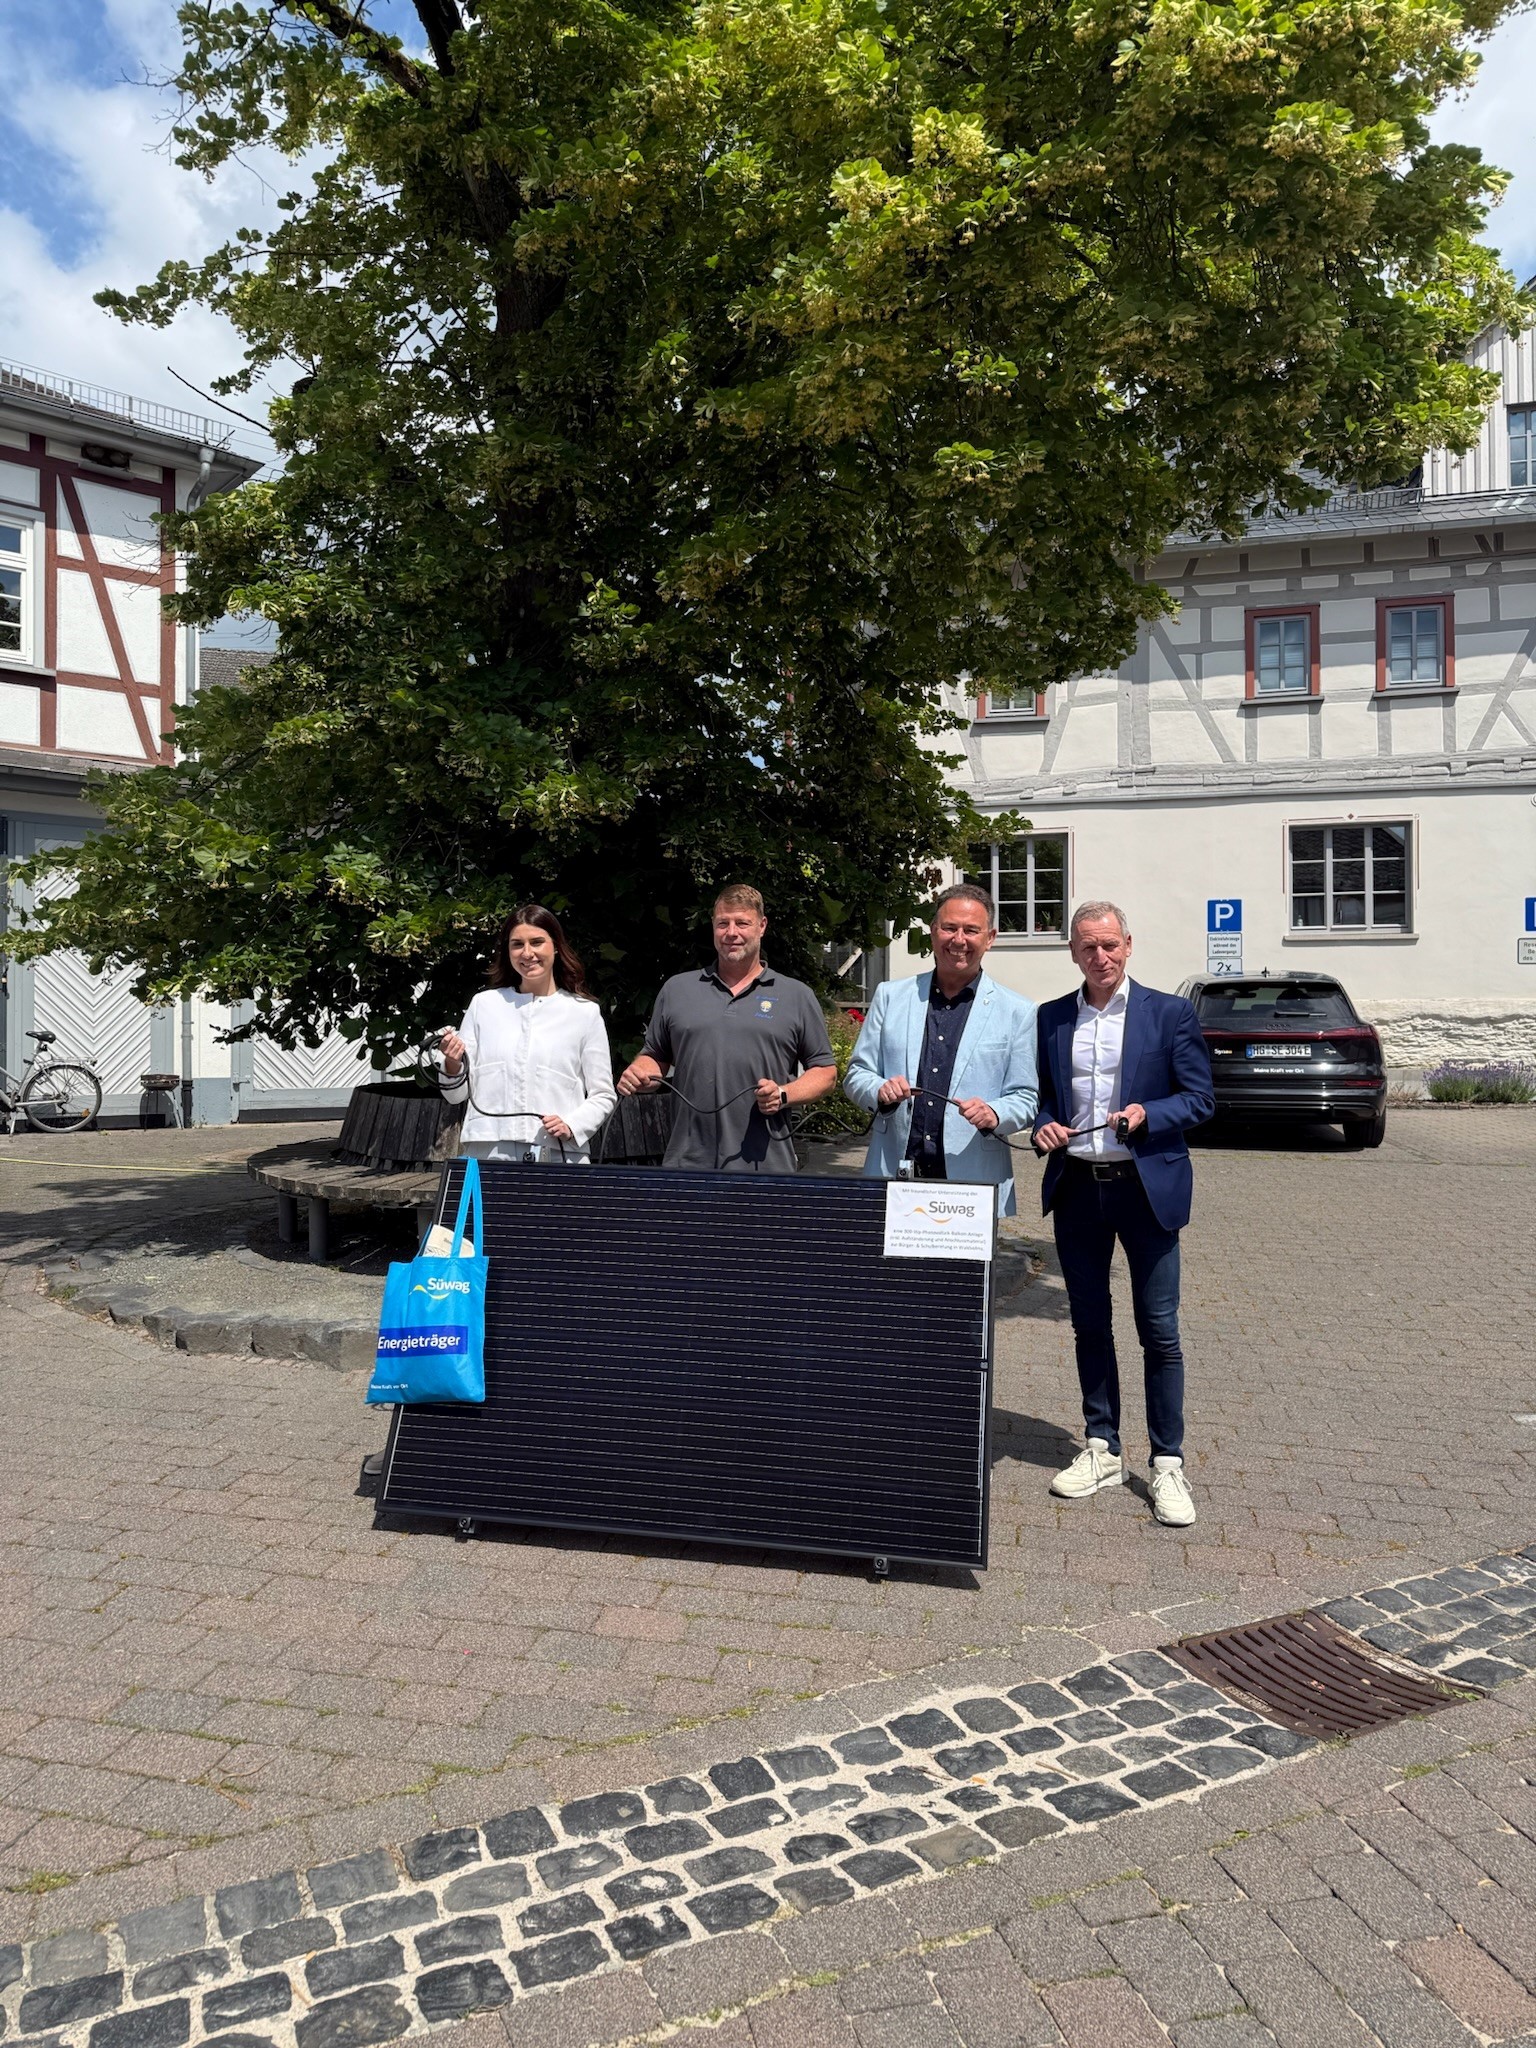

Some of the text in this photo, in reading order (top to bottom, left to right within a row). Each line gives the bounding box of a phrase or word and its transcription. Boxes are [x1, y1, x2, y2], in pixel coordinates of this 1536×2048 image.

[1215, 903, 1234, 928] P
[1217, 962, 1232, 972] 2x
[1253, 1045, 1265, 1055] HG
[1271, 1045, 1284, 1055] SE
[928, 1200, 975, 1218] Süwag
[427, 1278, 470, 1294] Süwag
[378, 1334, 461, 1352] Energieträger
